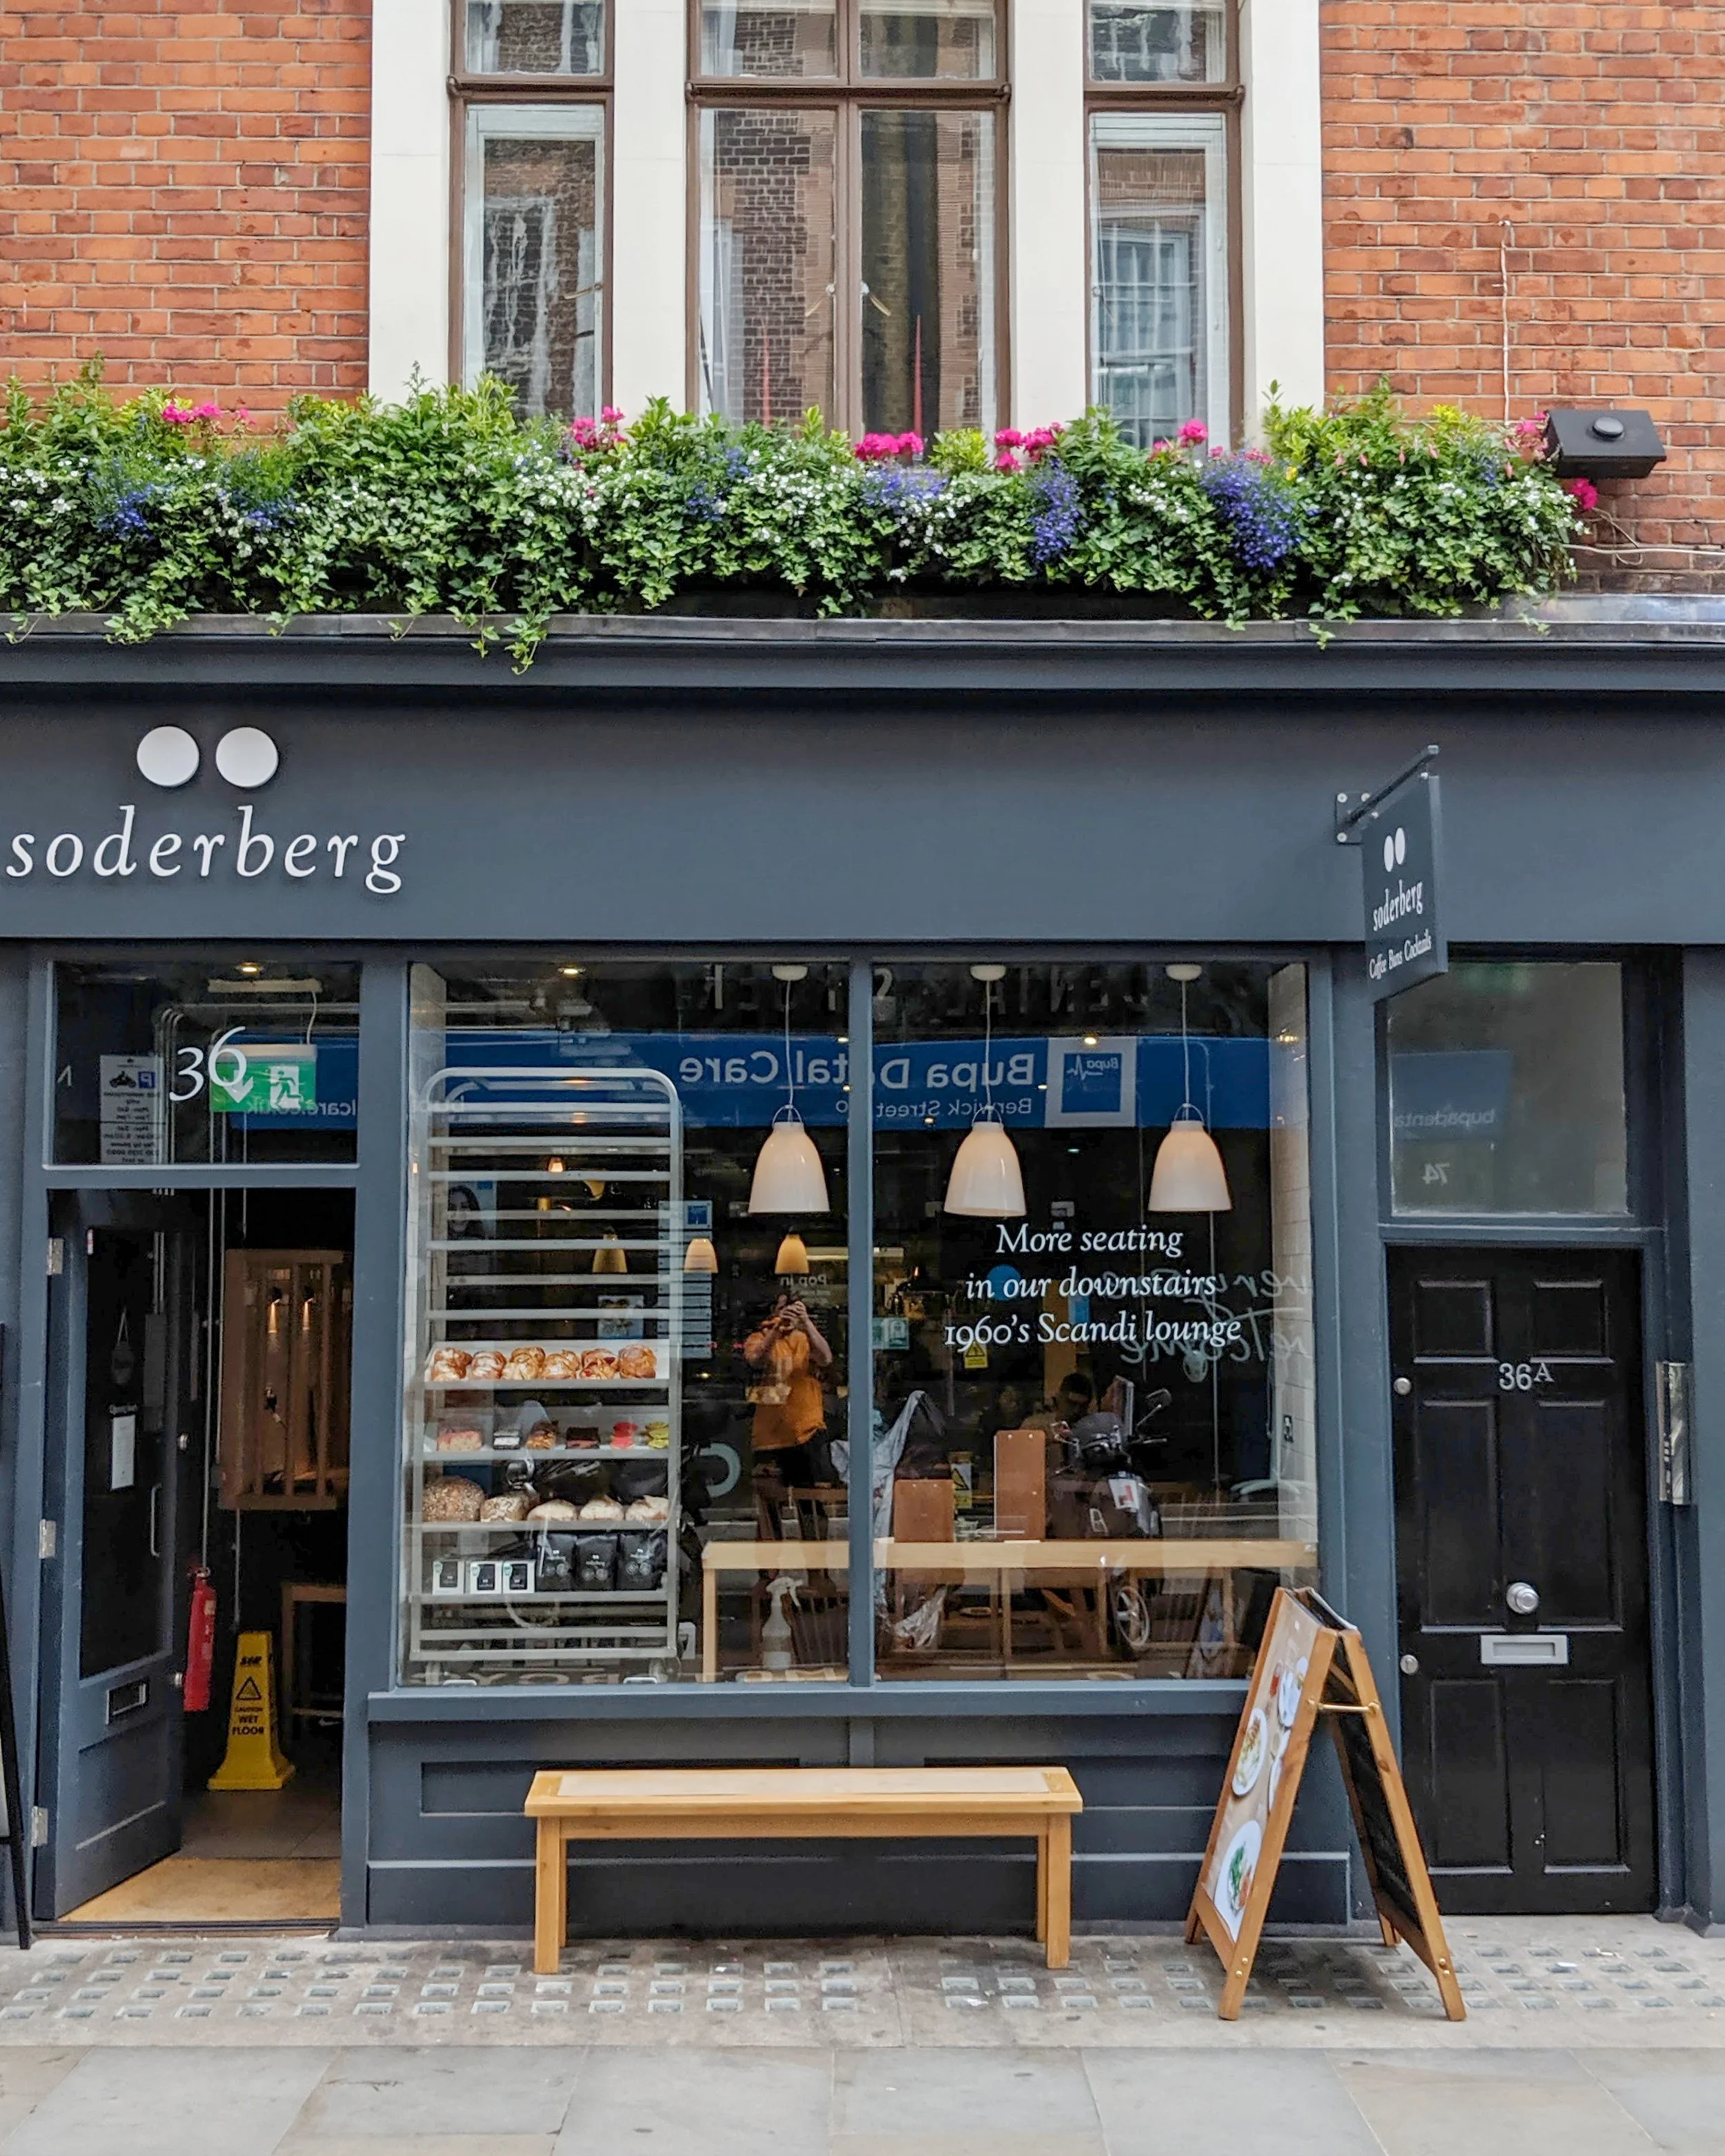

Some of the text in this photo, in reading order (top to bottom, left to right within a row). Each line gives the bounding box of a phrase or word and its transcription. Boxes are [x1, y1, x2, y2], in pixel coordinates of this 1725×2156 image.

[6, 804, 406, 894] soderberg
[1372, 879, 1423, 932] soderberg
[1369, 953, 1387, 980] Coffee
[168, 1026, 248, 1102] 36
[996, 1223, 1183, 1258] More seating
[965, 1272, 995, 1299] in
[1003, 1276, 1052, 1298] our
[1058, 1265, 1217, 1297] downstairs
[944, 1310, 1241, 1353] 1960's Scandi lounge
[1498, 1362, 1555, 1391] 36A
[232, 1726, 265, 1735] FLOOR
[239, 1716, 259, 1724] WET
